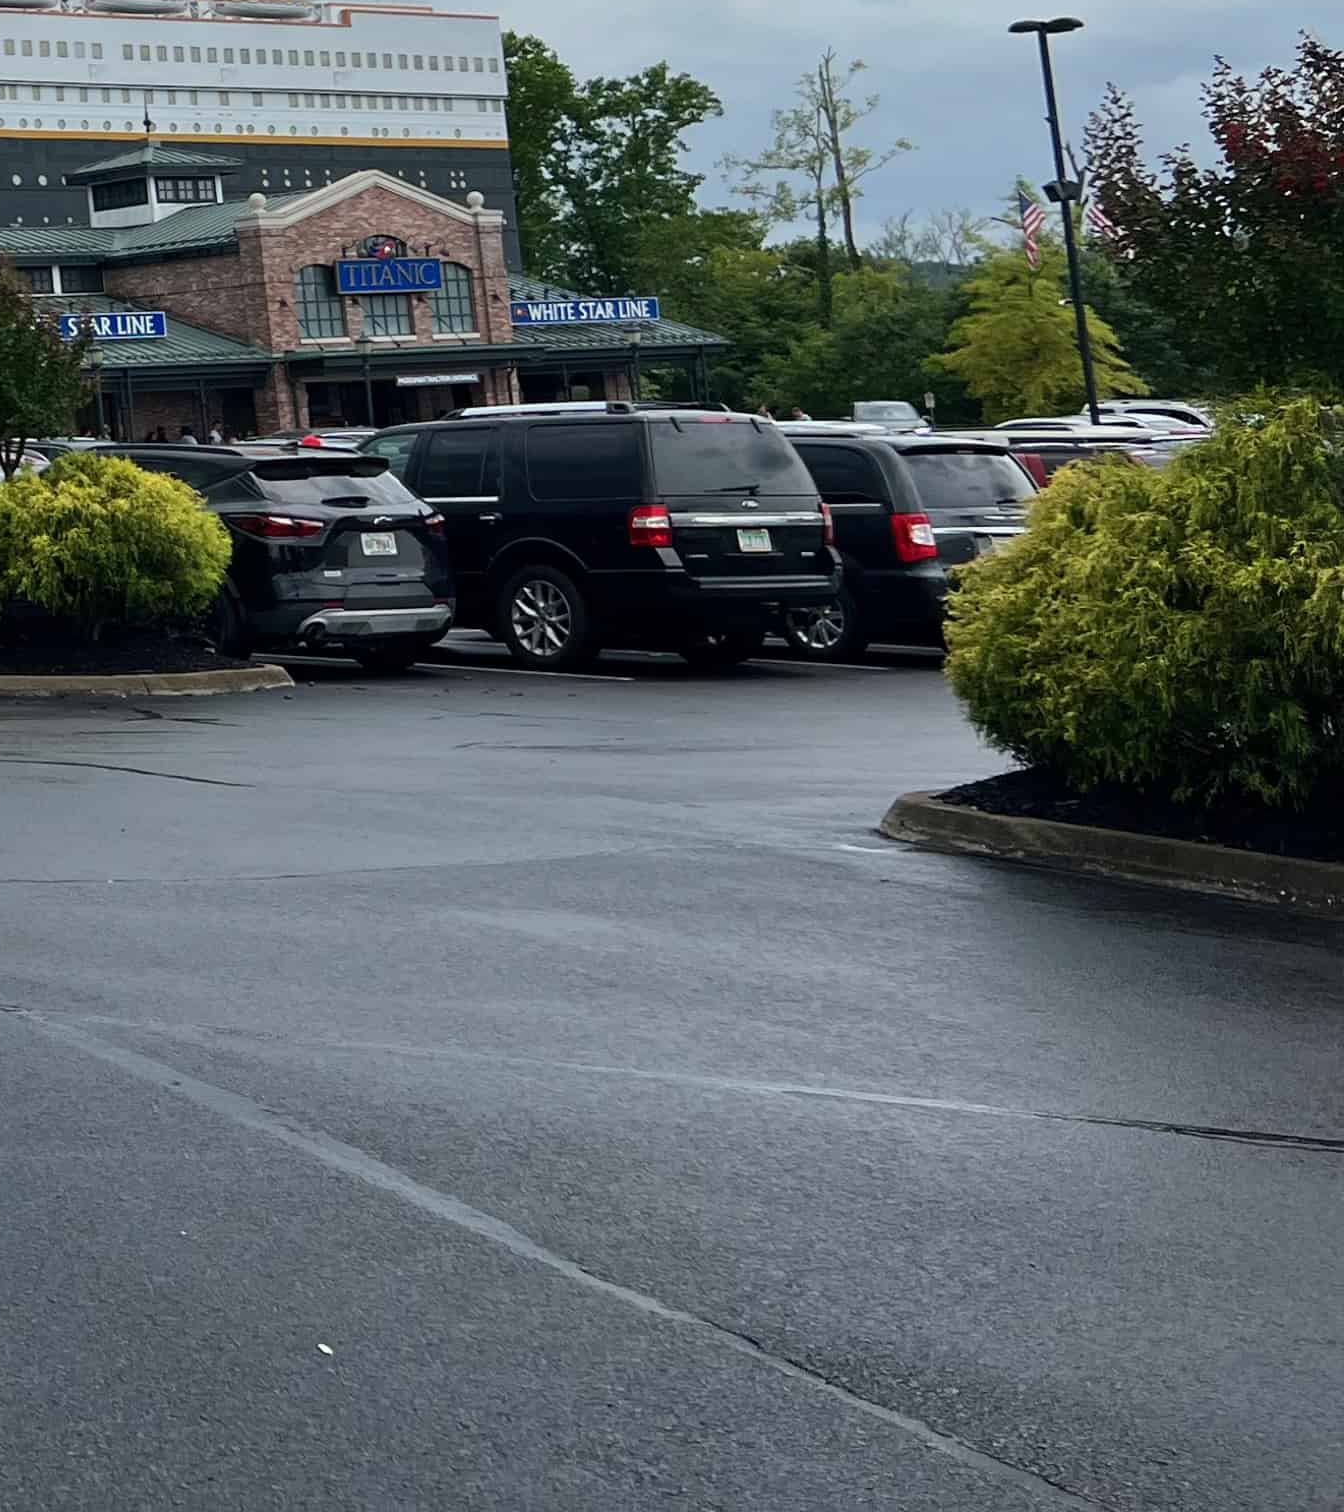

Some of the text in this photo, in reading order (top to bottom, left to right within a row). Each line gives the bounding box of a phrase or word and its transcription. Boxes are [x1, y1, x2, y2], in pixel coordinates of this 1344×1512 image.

[343, 263, 437, 287] TITANIC
[528, 300, 650, 321] WHITE STAR LINE
[116, 315, 156, 334] LINE
